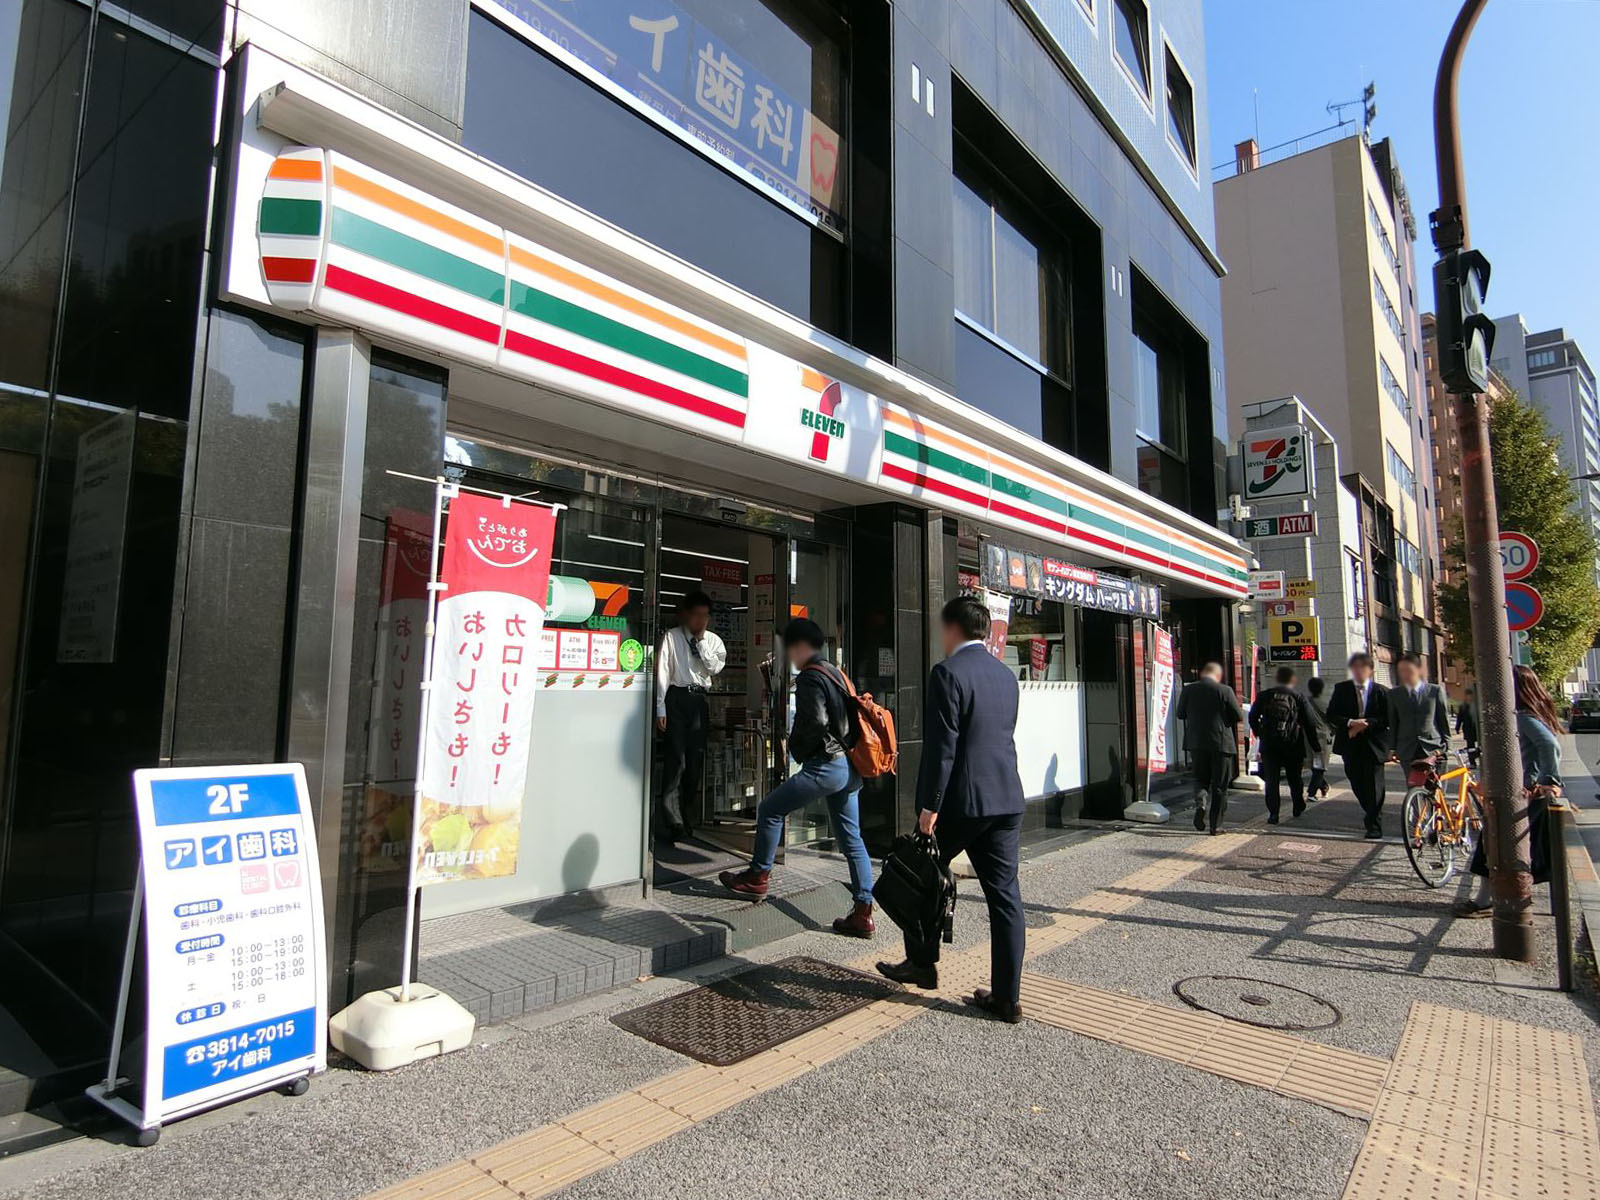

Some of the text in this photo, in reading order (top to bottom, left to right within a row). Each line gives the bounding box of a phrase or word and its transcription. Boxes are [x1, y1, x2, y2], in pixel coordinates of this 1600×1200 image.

[1253, 520, 1270, 536] 酒
[1282, 516, 1310, 533] ATM
[1281, 621, 1304, 643] P
[206, 783, 249, 815] 2F
[166, 829, 298, 868] アイ歯科
[207, 1019, 296, 1058] 3814-7015
[211, 1045, 272, 1077] アイ歯科
